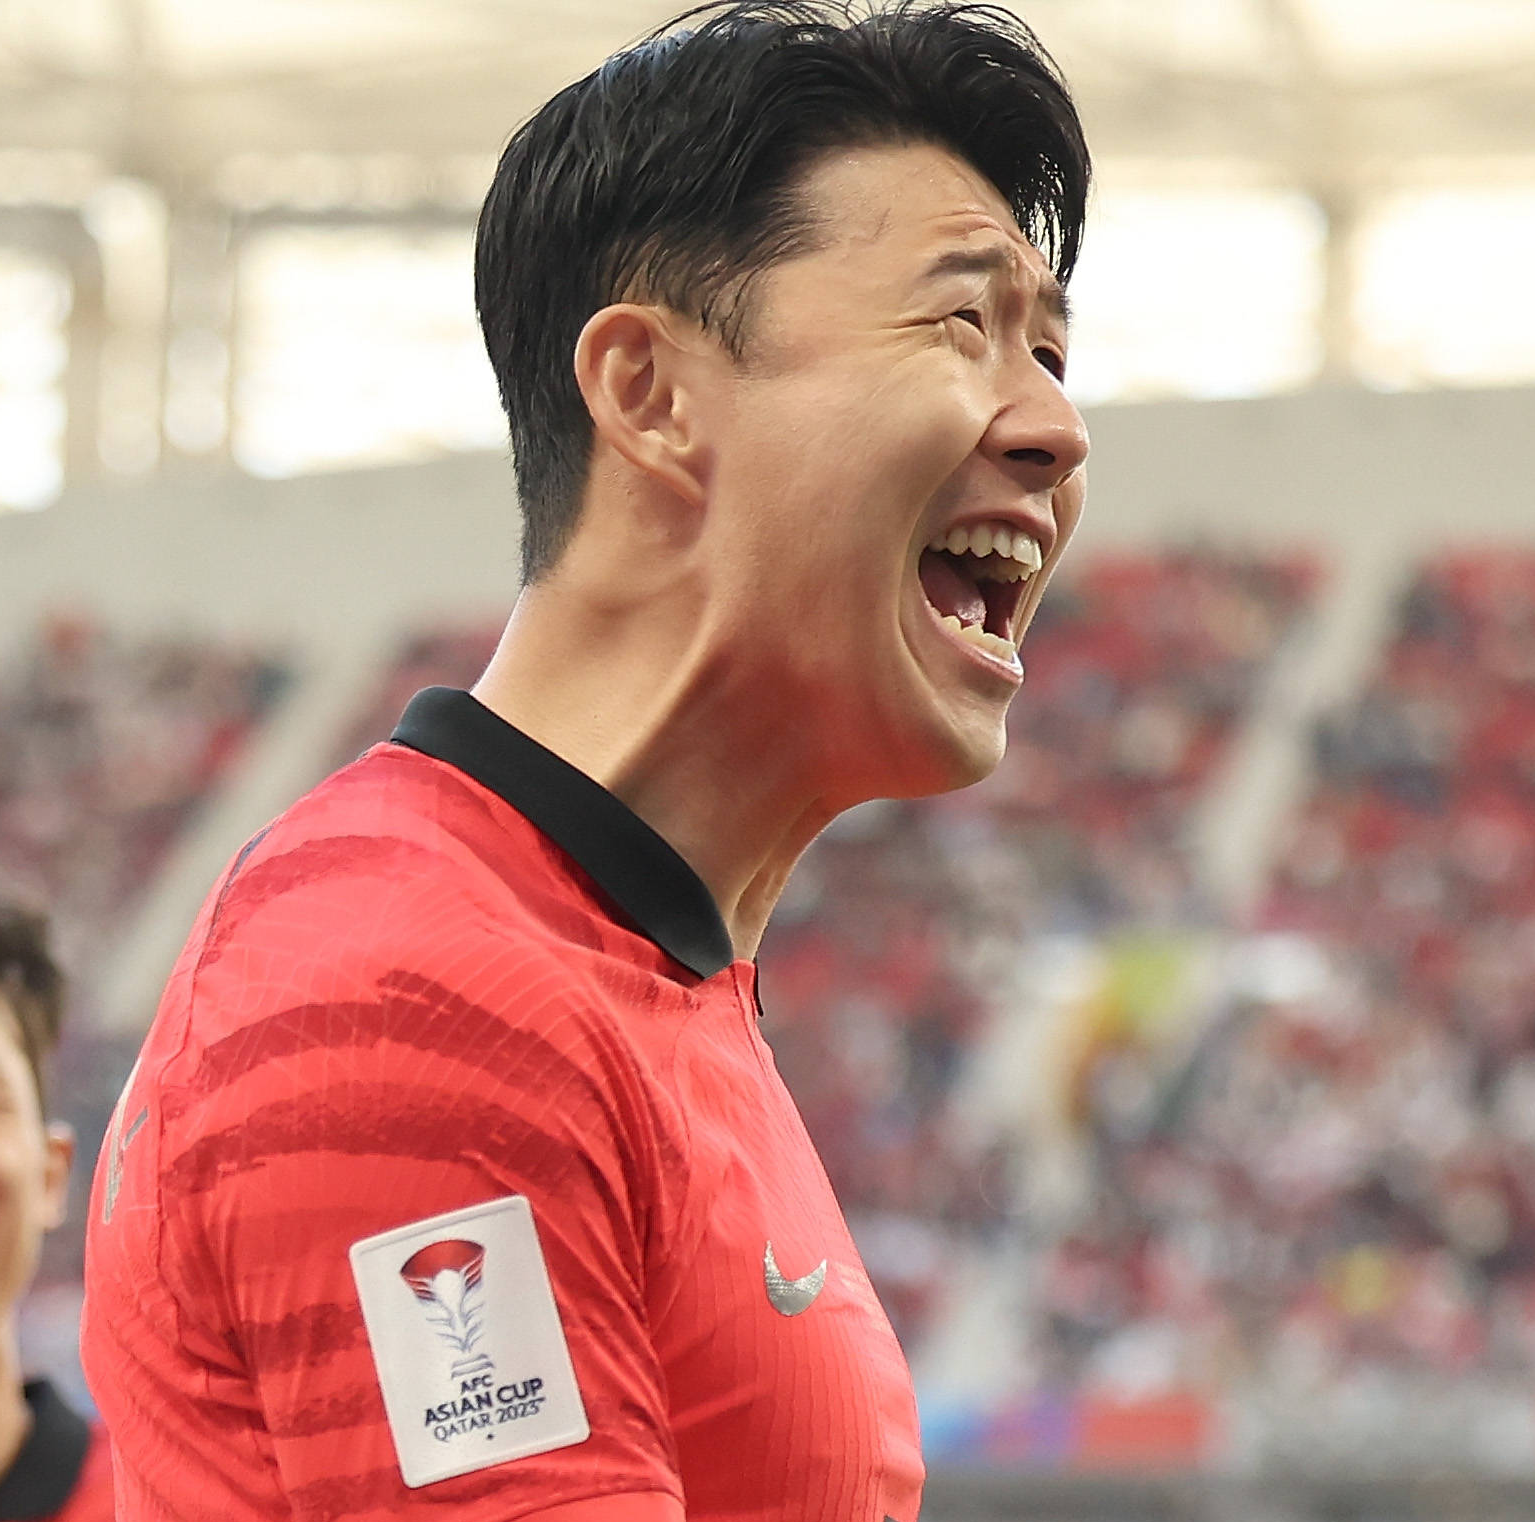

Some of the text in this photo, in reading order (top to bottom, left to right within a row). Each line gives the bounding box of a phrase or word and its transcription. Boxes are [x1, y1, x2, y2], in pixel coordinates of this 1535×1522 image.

[425, 1377, 544, 1427] ASIAN CUP
[460, 1374, 494, 1394] AFC
[433, 1397, 546, 1443] QATAR 2023
